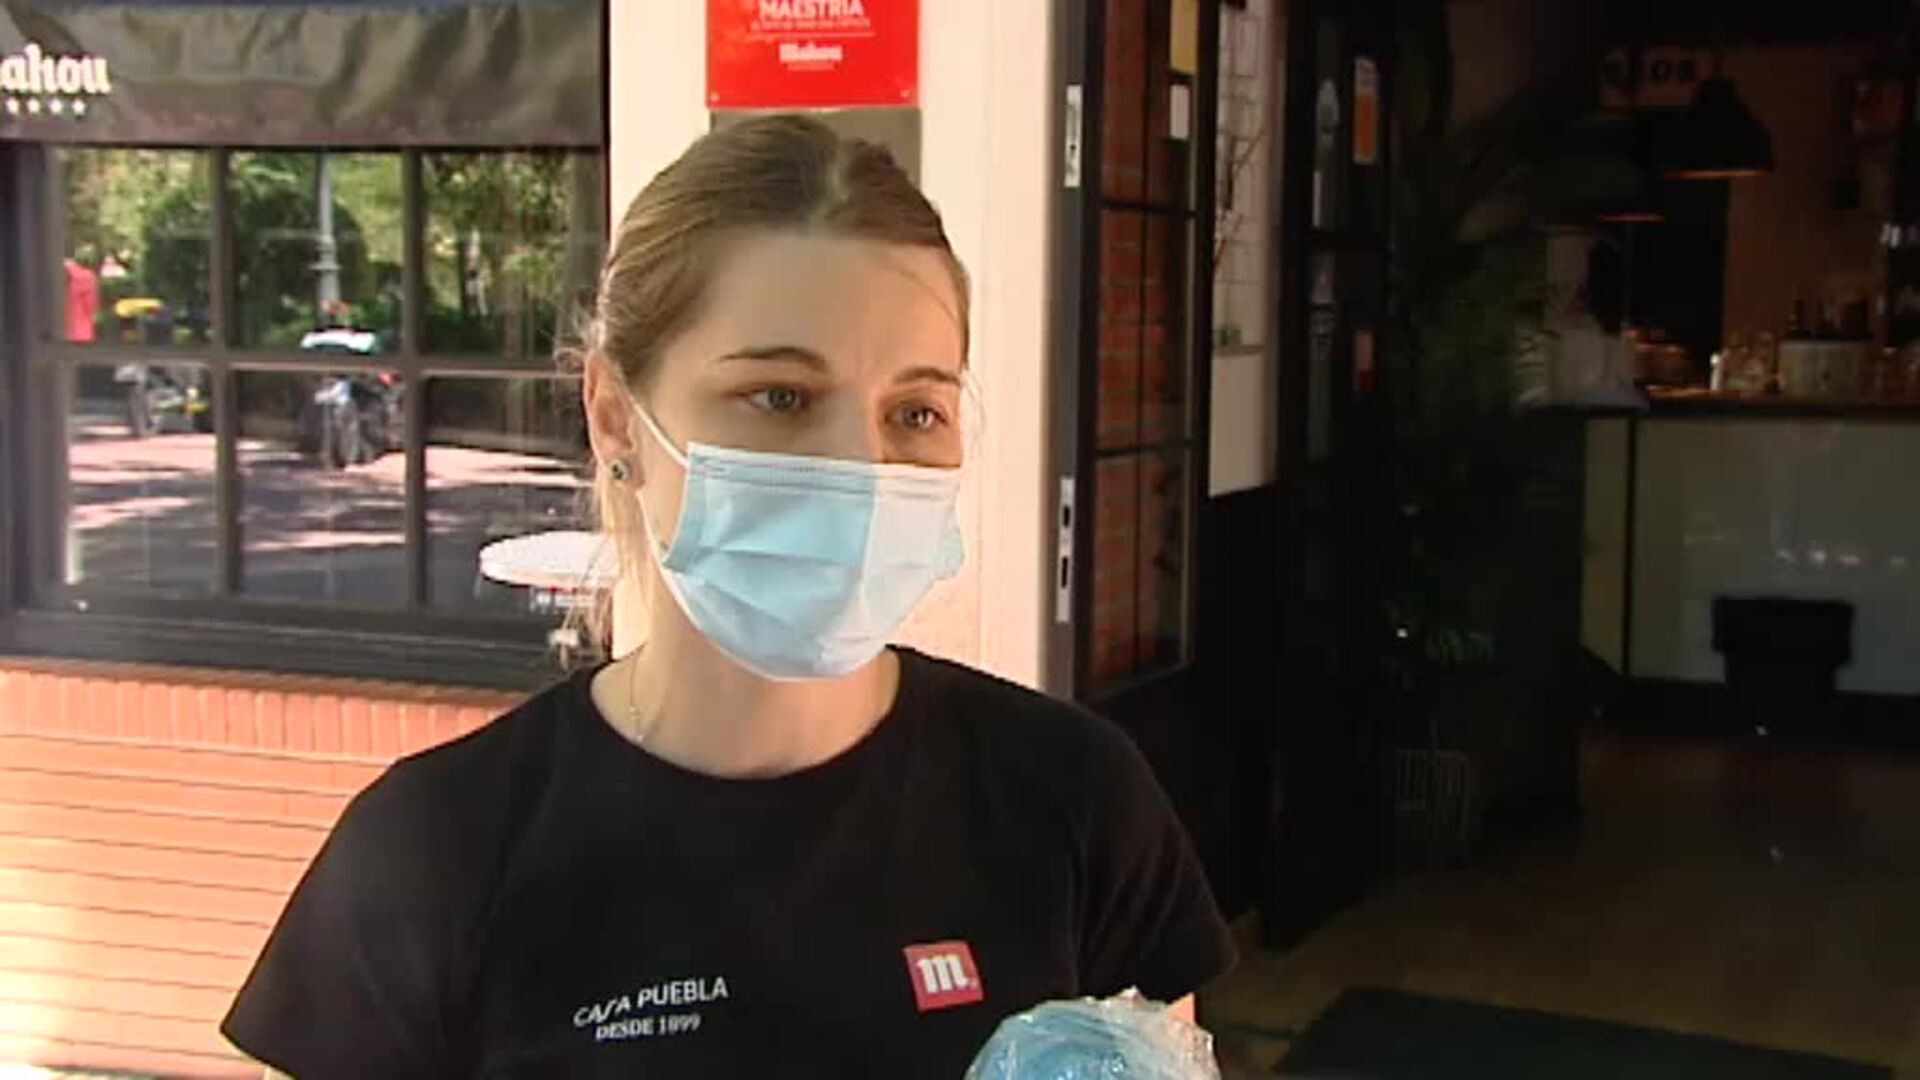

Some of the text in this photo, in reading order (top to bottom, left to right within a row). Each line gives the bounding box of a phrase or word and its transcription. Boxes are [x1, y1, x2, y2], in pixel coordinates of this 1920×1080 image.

[0, 43, 111, 94] ahou
[637, 976, 728, 1009] PUEBLA
[595, 1018, 654, 1041] DESDE
